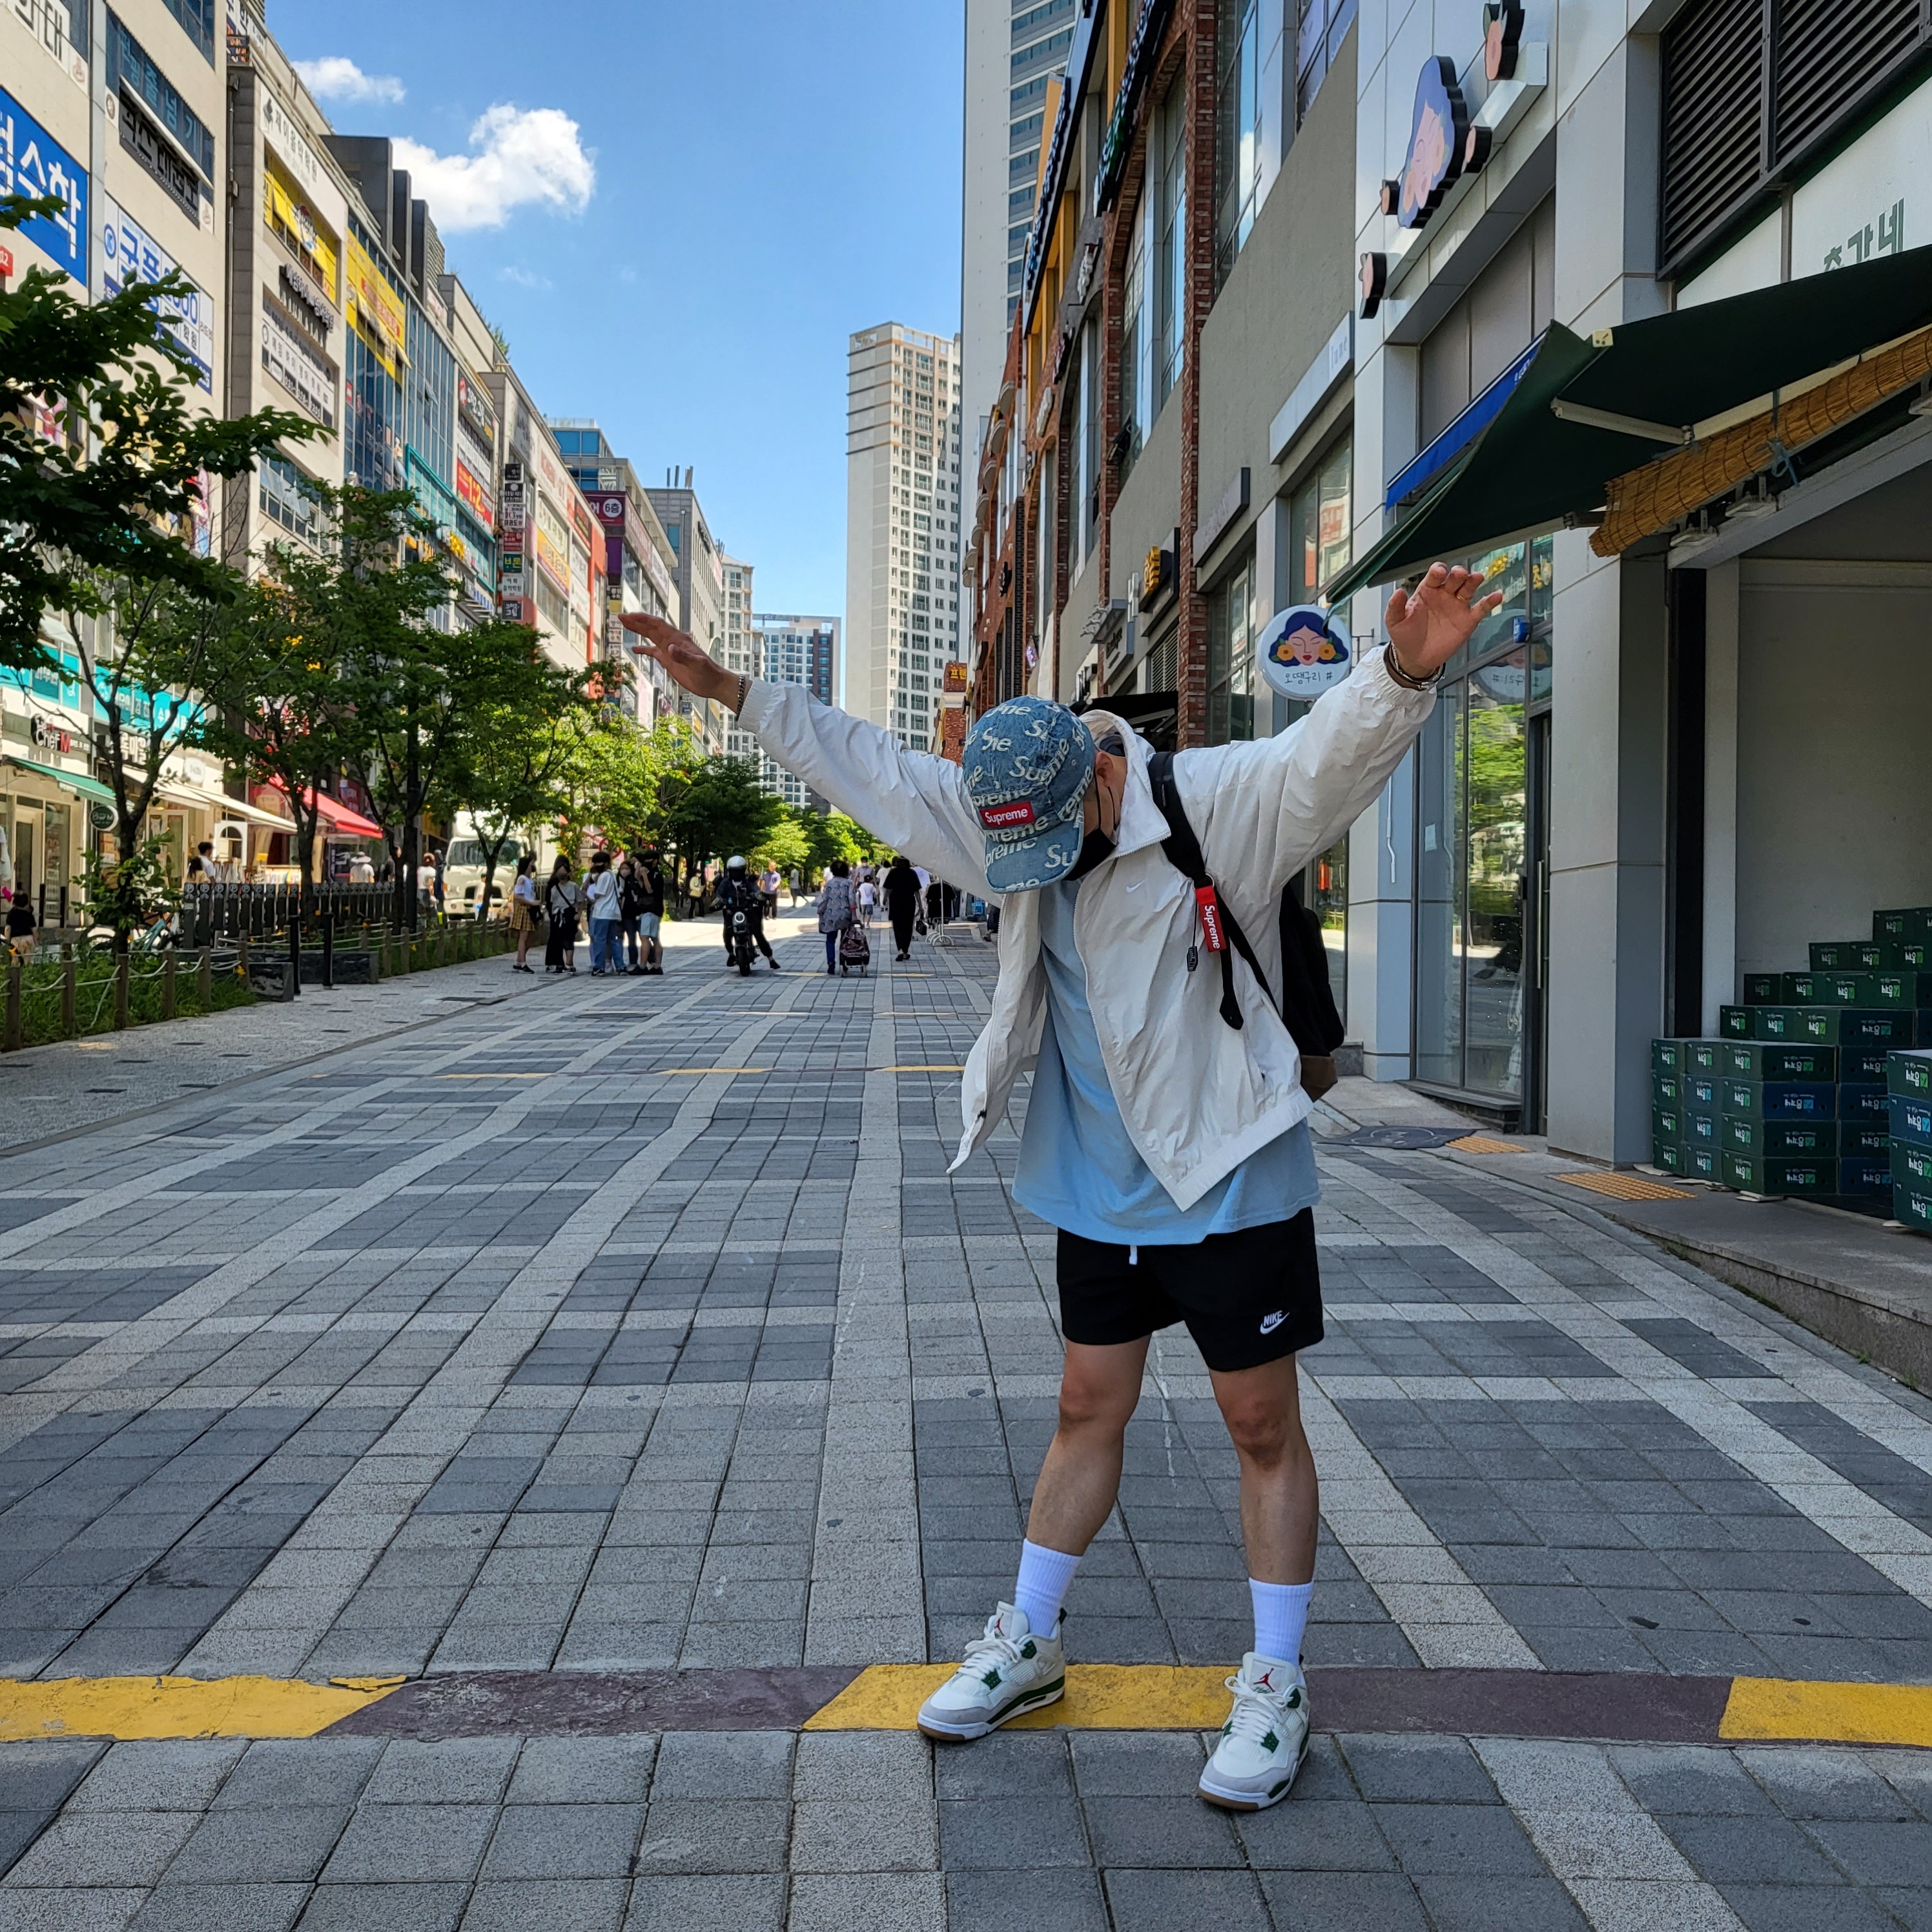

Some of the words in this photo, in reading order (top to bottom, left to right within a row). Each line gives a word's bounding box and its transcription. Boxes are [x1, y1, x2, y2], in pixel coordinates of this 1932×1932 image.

[0, 108, 81, 260] 수학
[605, 504, 621, 515] 6층
[1284, 671, 1321, 684] 오땡구리
[984, 807, 1029, 825] Supreme
[1204, 904, 1220, 949] Supreme
[1263, 1310, 1283, 1327] NIKE
